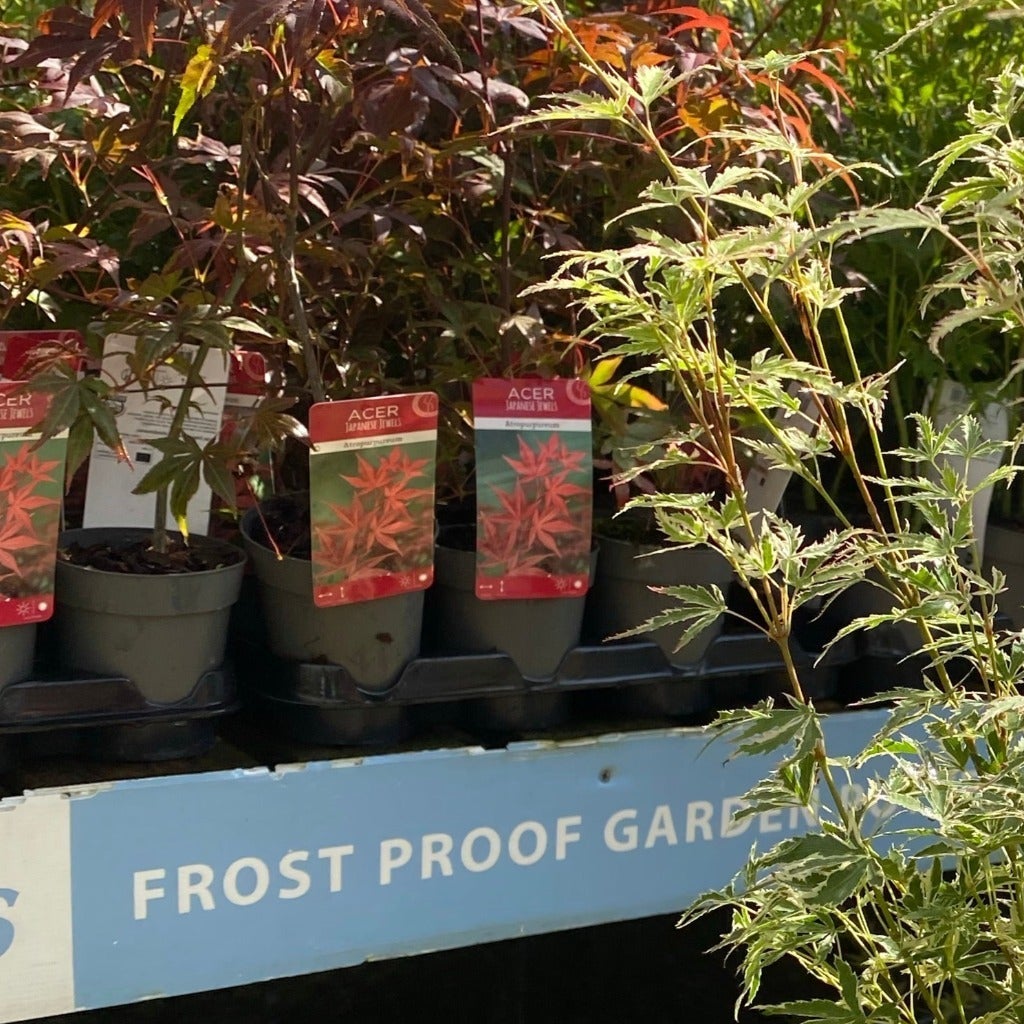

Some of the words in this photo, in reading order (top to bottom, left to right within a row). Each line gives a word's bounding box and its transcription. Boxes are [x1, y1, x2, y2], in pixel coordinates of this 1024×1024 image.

[508, 387, 554, 400] ACER
[348, 405, 399, 421] ACER
[133, 844, 354, 920] FROST
[380, 816, 582, 885] PROOF
[604, 786, 821, 852] GARDEN
